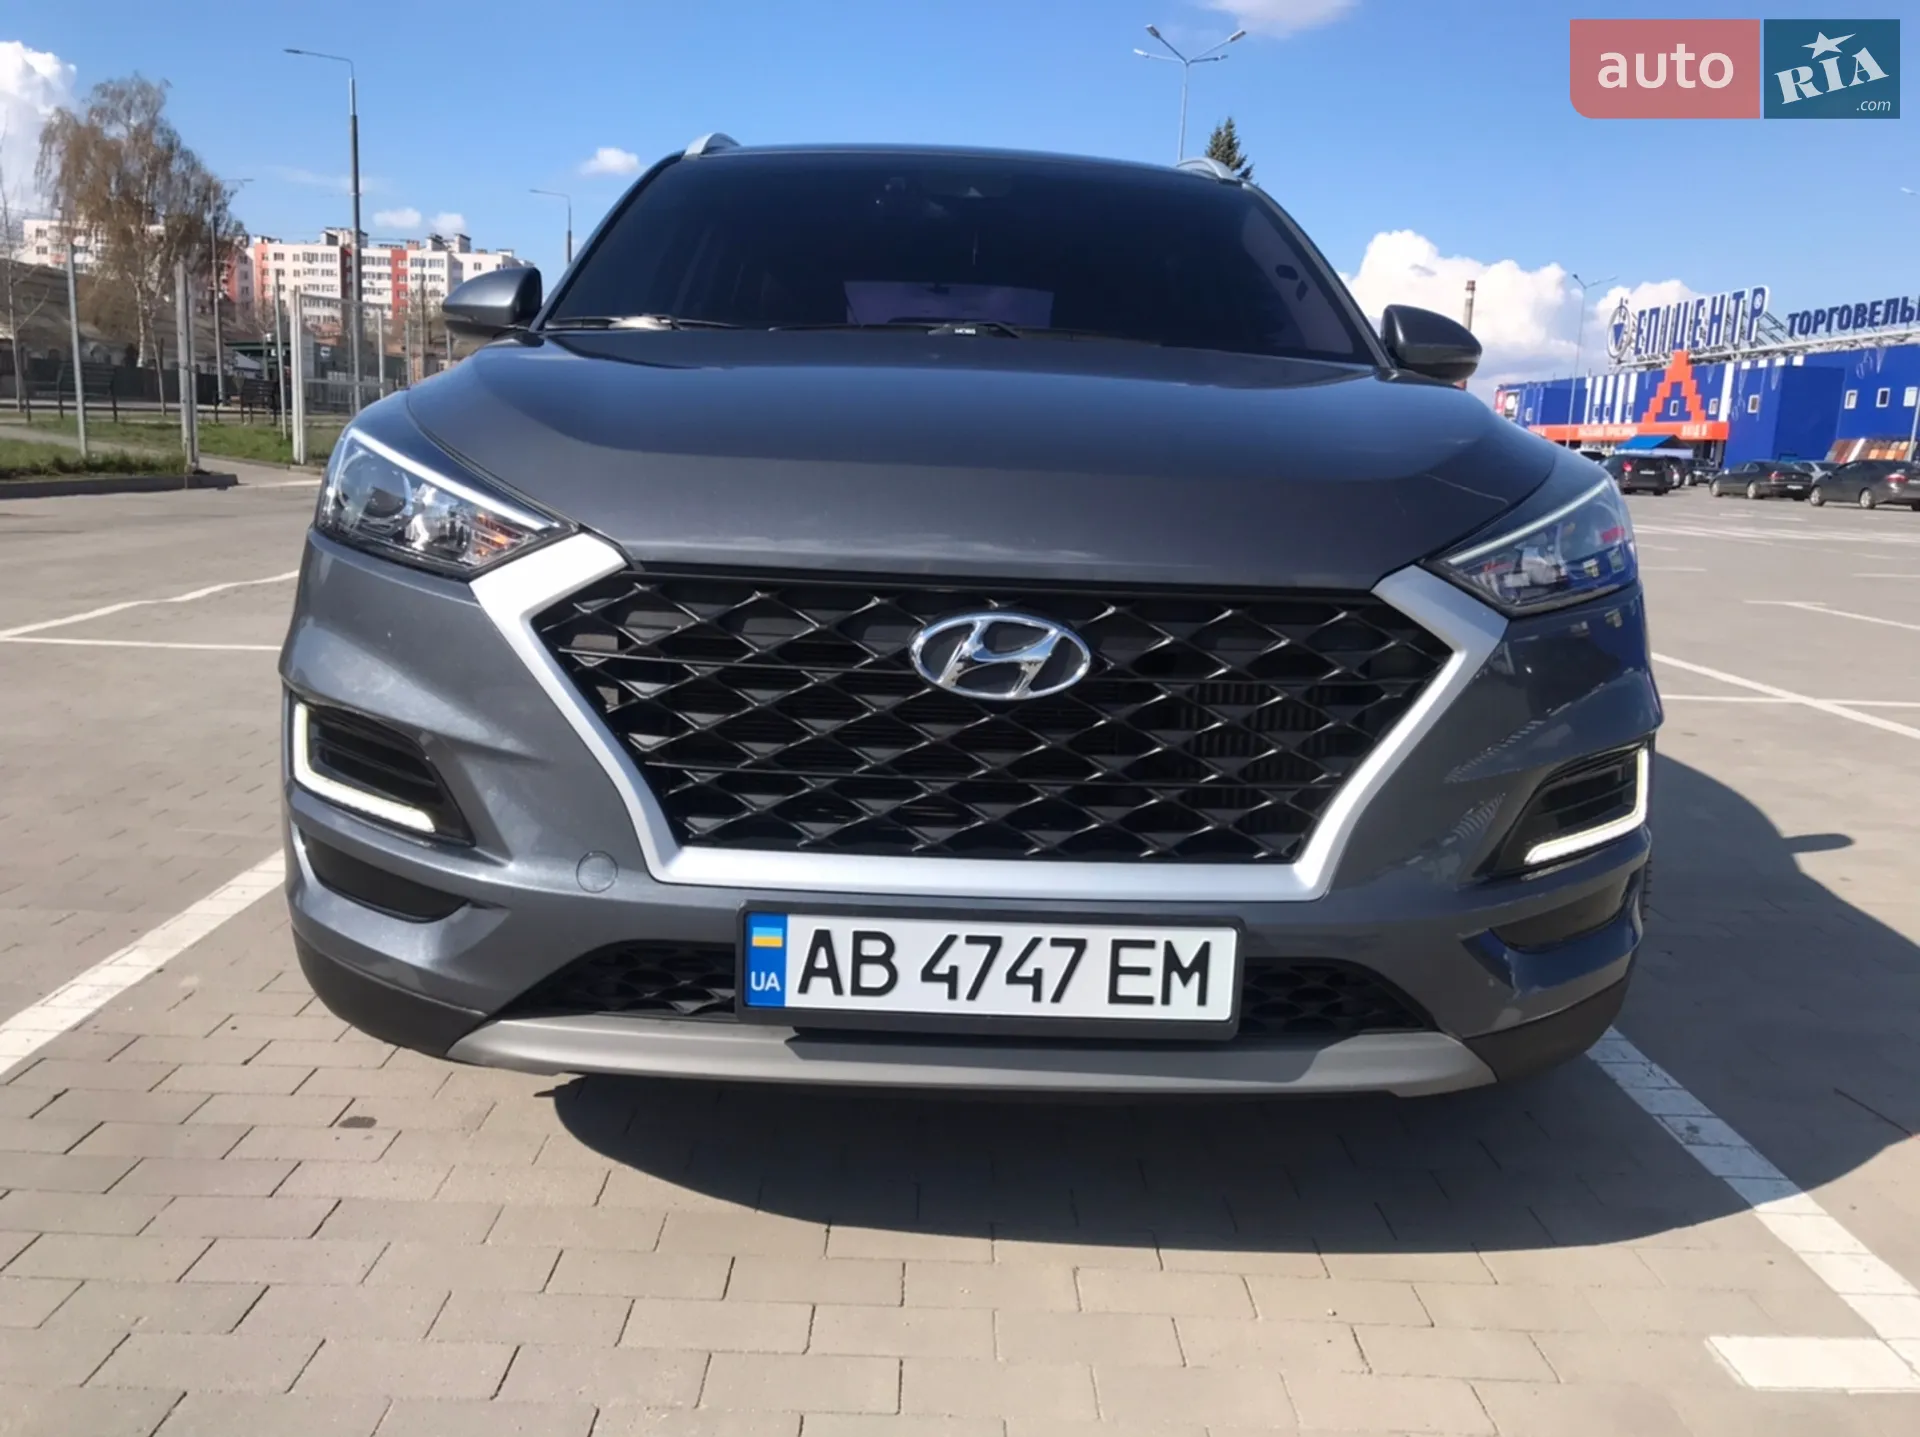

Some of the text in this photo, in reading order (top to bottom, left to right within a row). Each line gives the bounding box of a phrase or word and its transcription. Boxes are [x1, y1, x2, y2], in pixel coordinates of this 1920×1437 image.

[1634, 285, 1920, 356] ЕПІЦЕНТР ТОРГОВЕЛЬ
[750, 972, 781, 992] UA
[797, 929, 1211, 1006] AB 4747 EM
